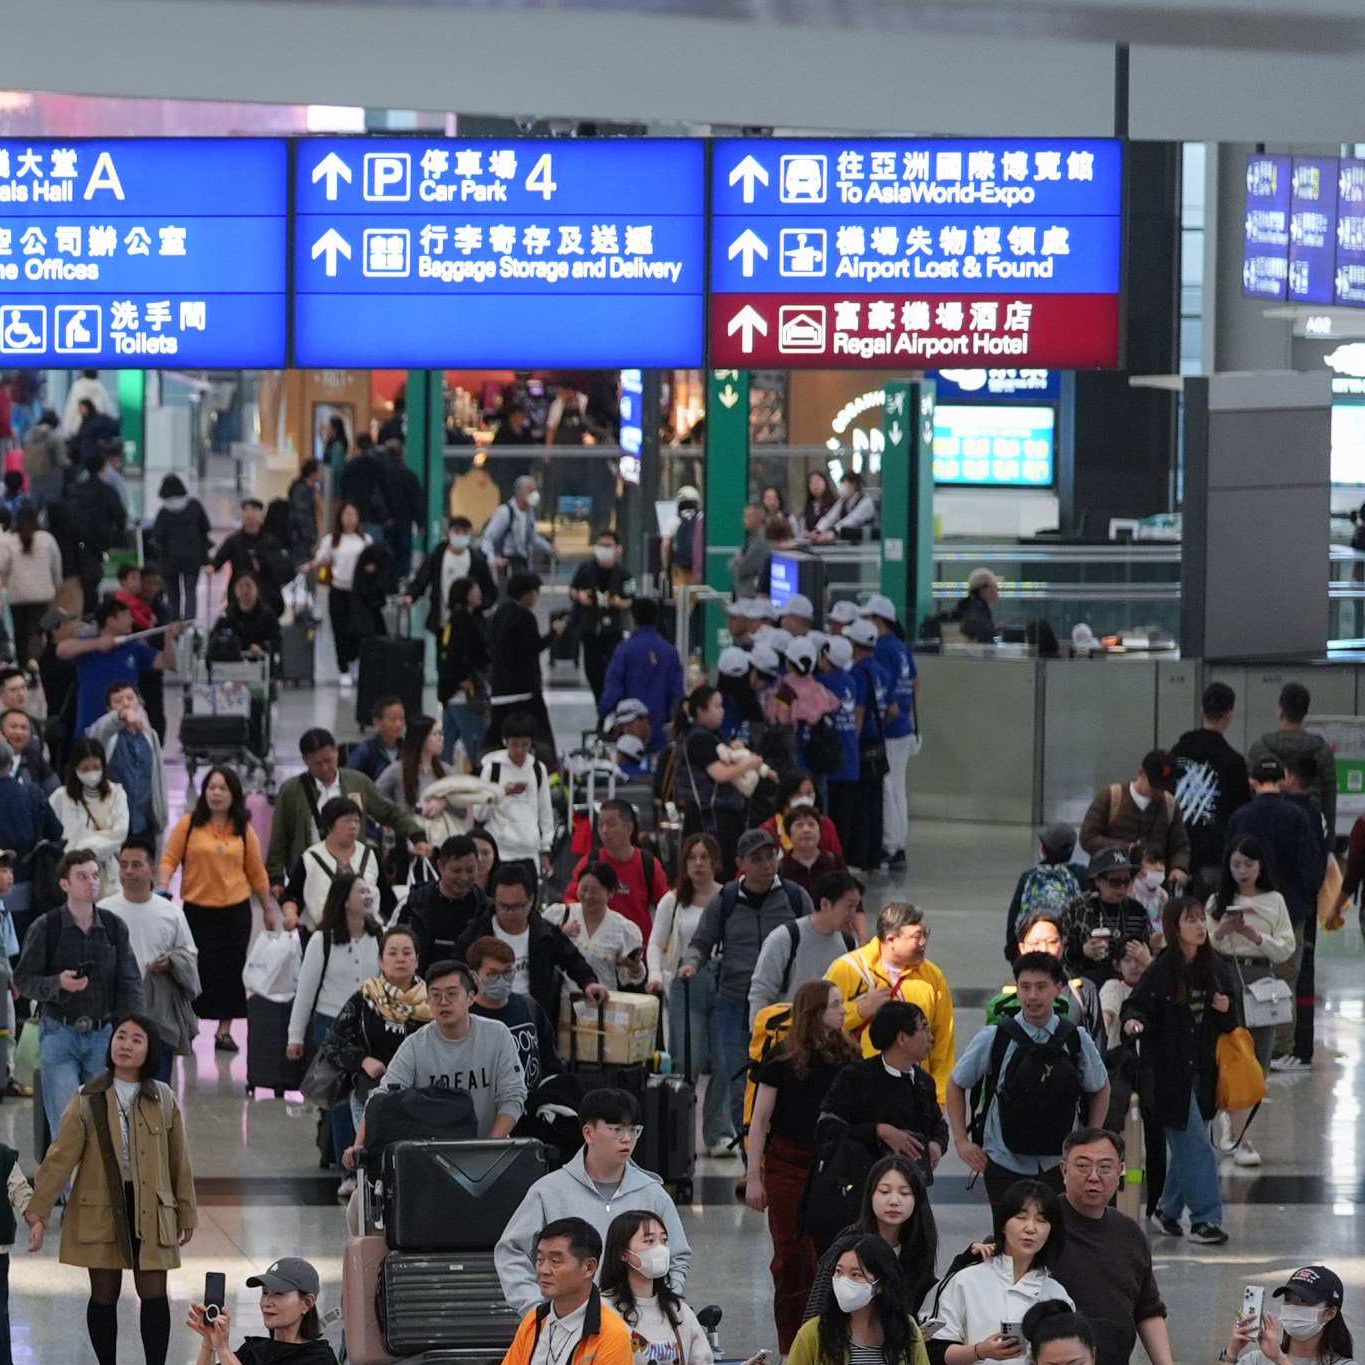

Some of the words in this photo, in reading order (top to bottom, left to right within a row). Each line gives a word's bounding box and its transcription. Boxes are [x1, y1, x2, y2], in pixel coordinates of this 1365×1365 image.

[84, 152, 125, 200] A
[374, 158, 404, 196] P
[420, 149, 517, 179] 停車場
[526, 154, 557, 200] 4
[837, 151, 1094, 181] 往亞洲國際博覽館
[33, 180, 73, 202] Hall
[419, 181, 454, 201] Car
[461, 180, 507, 201] Park
[836, 182, 862, 203] To
[865, 182, 1035, 207] AsiaWorld-Expo
[836, 226, 1070, 255] 機場失物認領處
[25, 259, 99, 281] Offices
[419, 257, 496, 282] Baggage
[500, 256, 569, 282] Storage
[572, 257, 612, 278] and
[613, 257, 682, 282] Delivery
[836, 256, 910, 282] Airport
[914, 257, 959, 278] Lost
[963, 256, 982, 278] &
[987, 256, 1053, 278] Found
[110, 301, 205, 331] 洗手間
[834, 301, 1032, 331] 富豪機場酒店
[110, 333, 177, 354] Toilets
[834, 333, 891, 358] Regal
[894, 333, 969, 358] Airport
[973, 333, 1028, 354] Hotel
[429, 1068, 490, 1090] IDEAL
